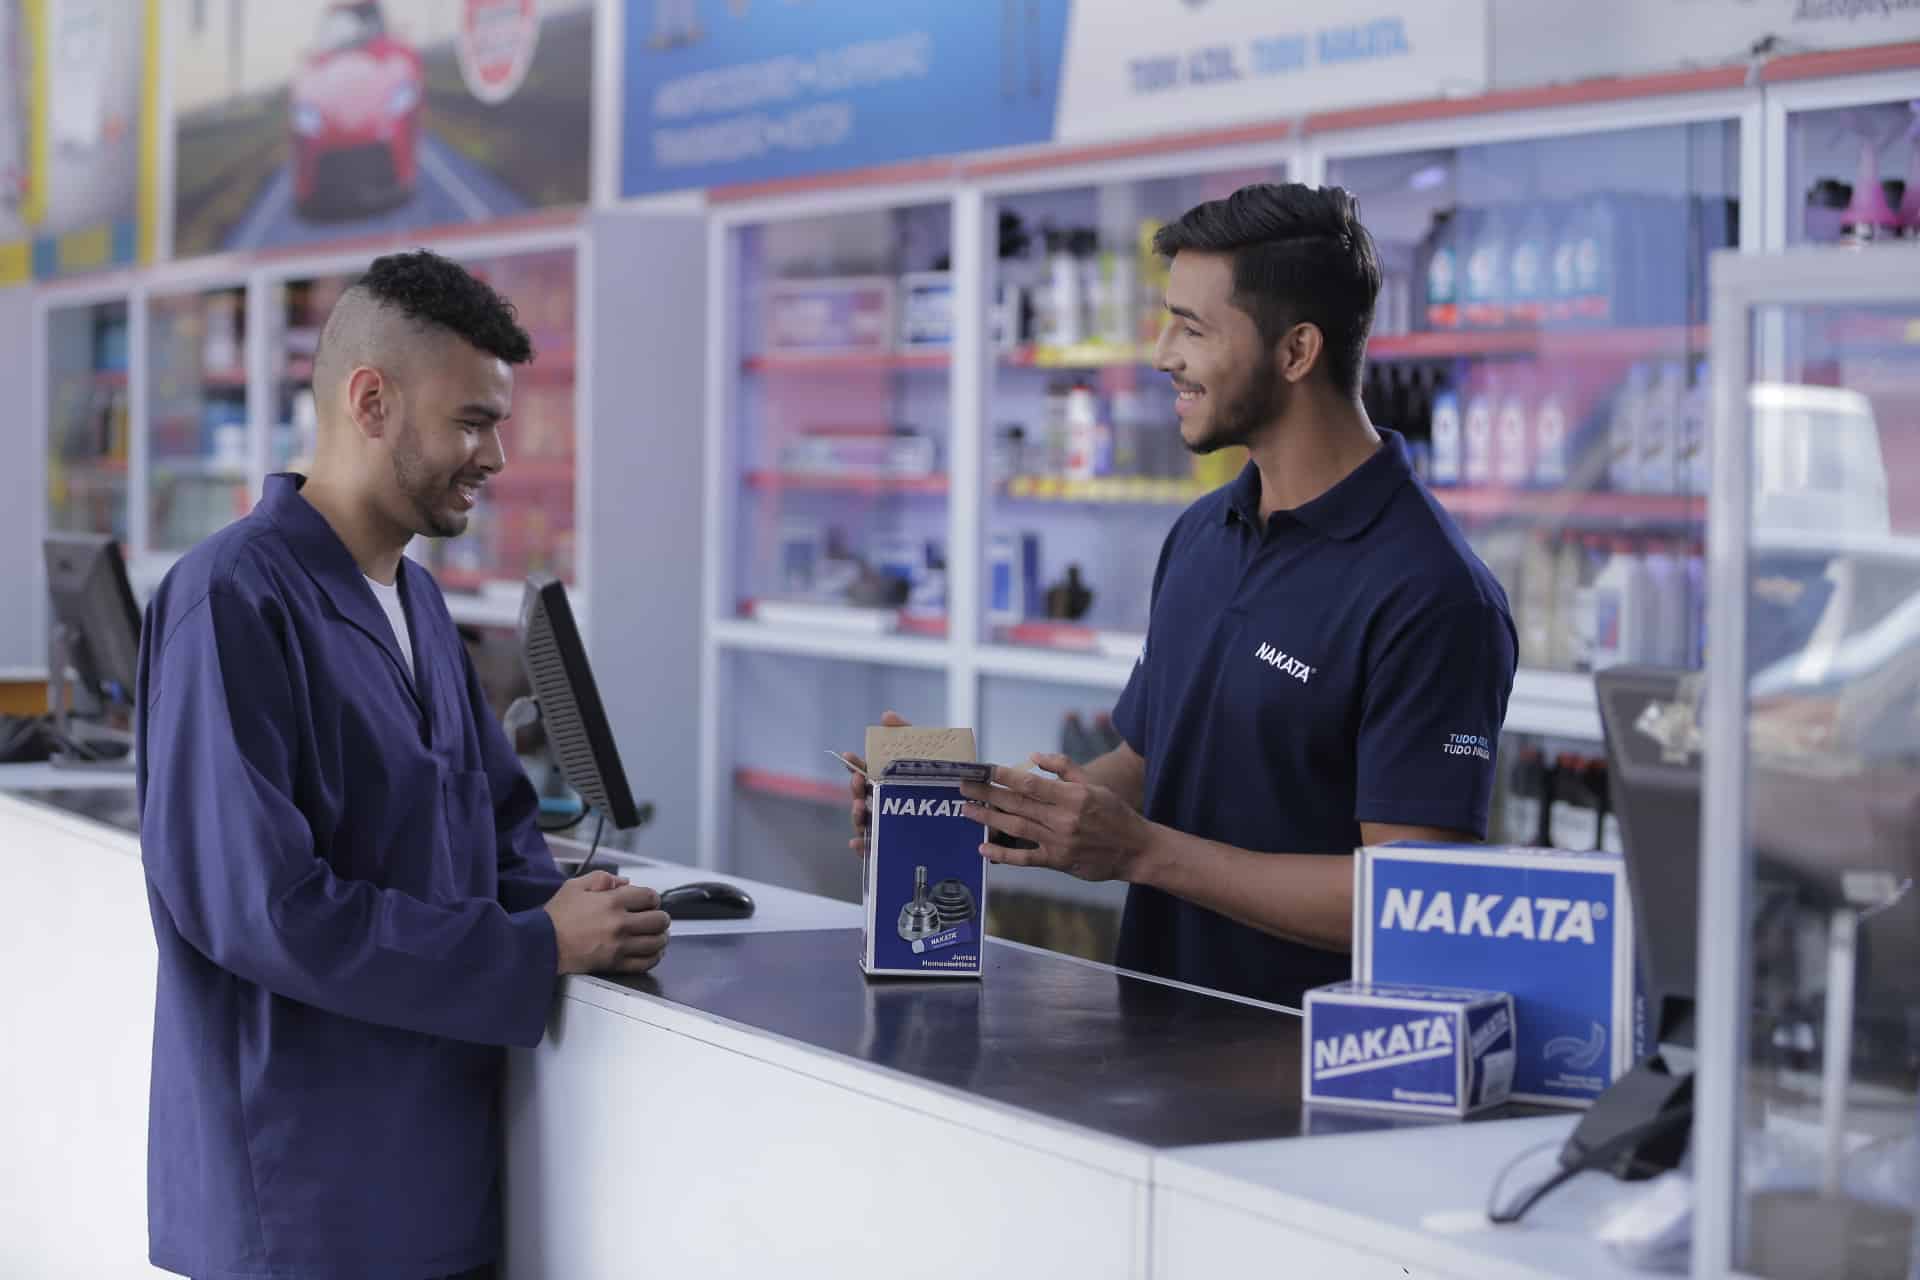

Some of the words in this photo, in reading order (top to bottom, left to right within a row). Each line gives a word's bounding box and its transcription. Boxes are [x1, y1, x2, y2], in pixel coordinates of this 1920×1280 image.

[1255, 641, 1310, 683] NAKATA
[1449, 733, 1477, 744] TUDO
[1443, 743, 1471, 755] TUDO
[881, 797, 967, 817] NAKAT
[1313, 1016, 1453, 1070] NAKATA
